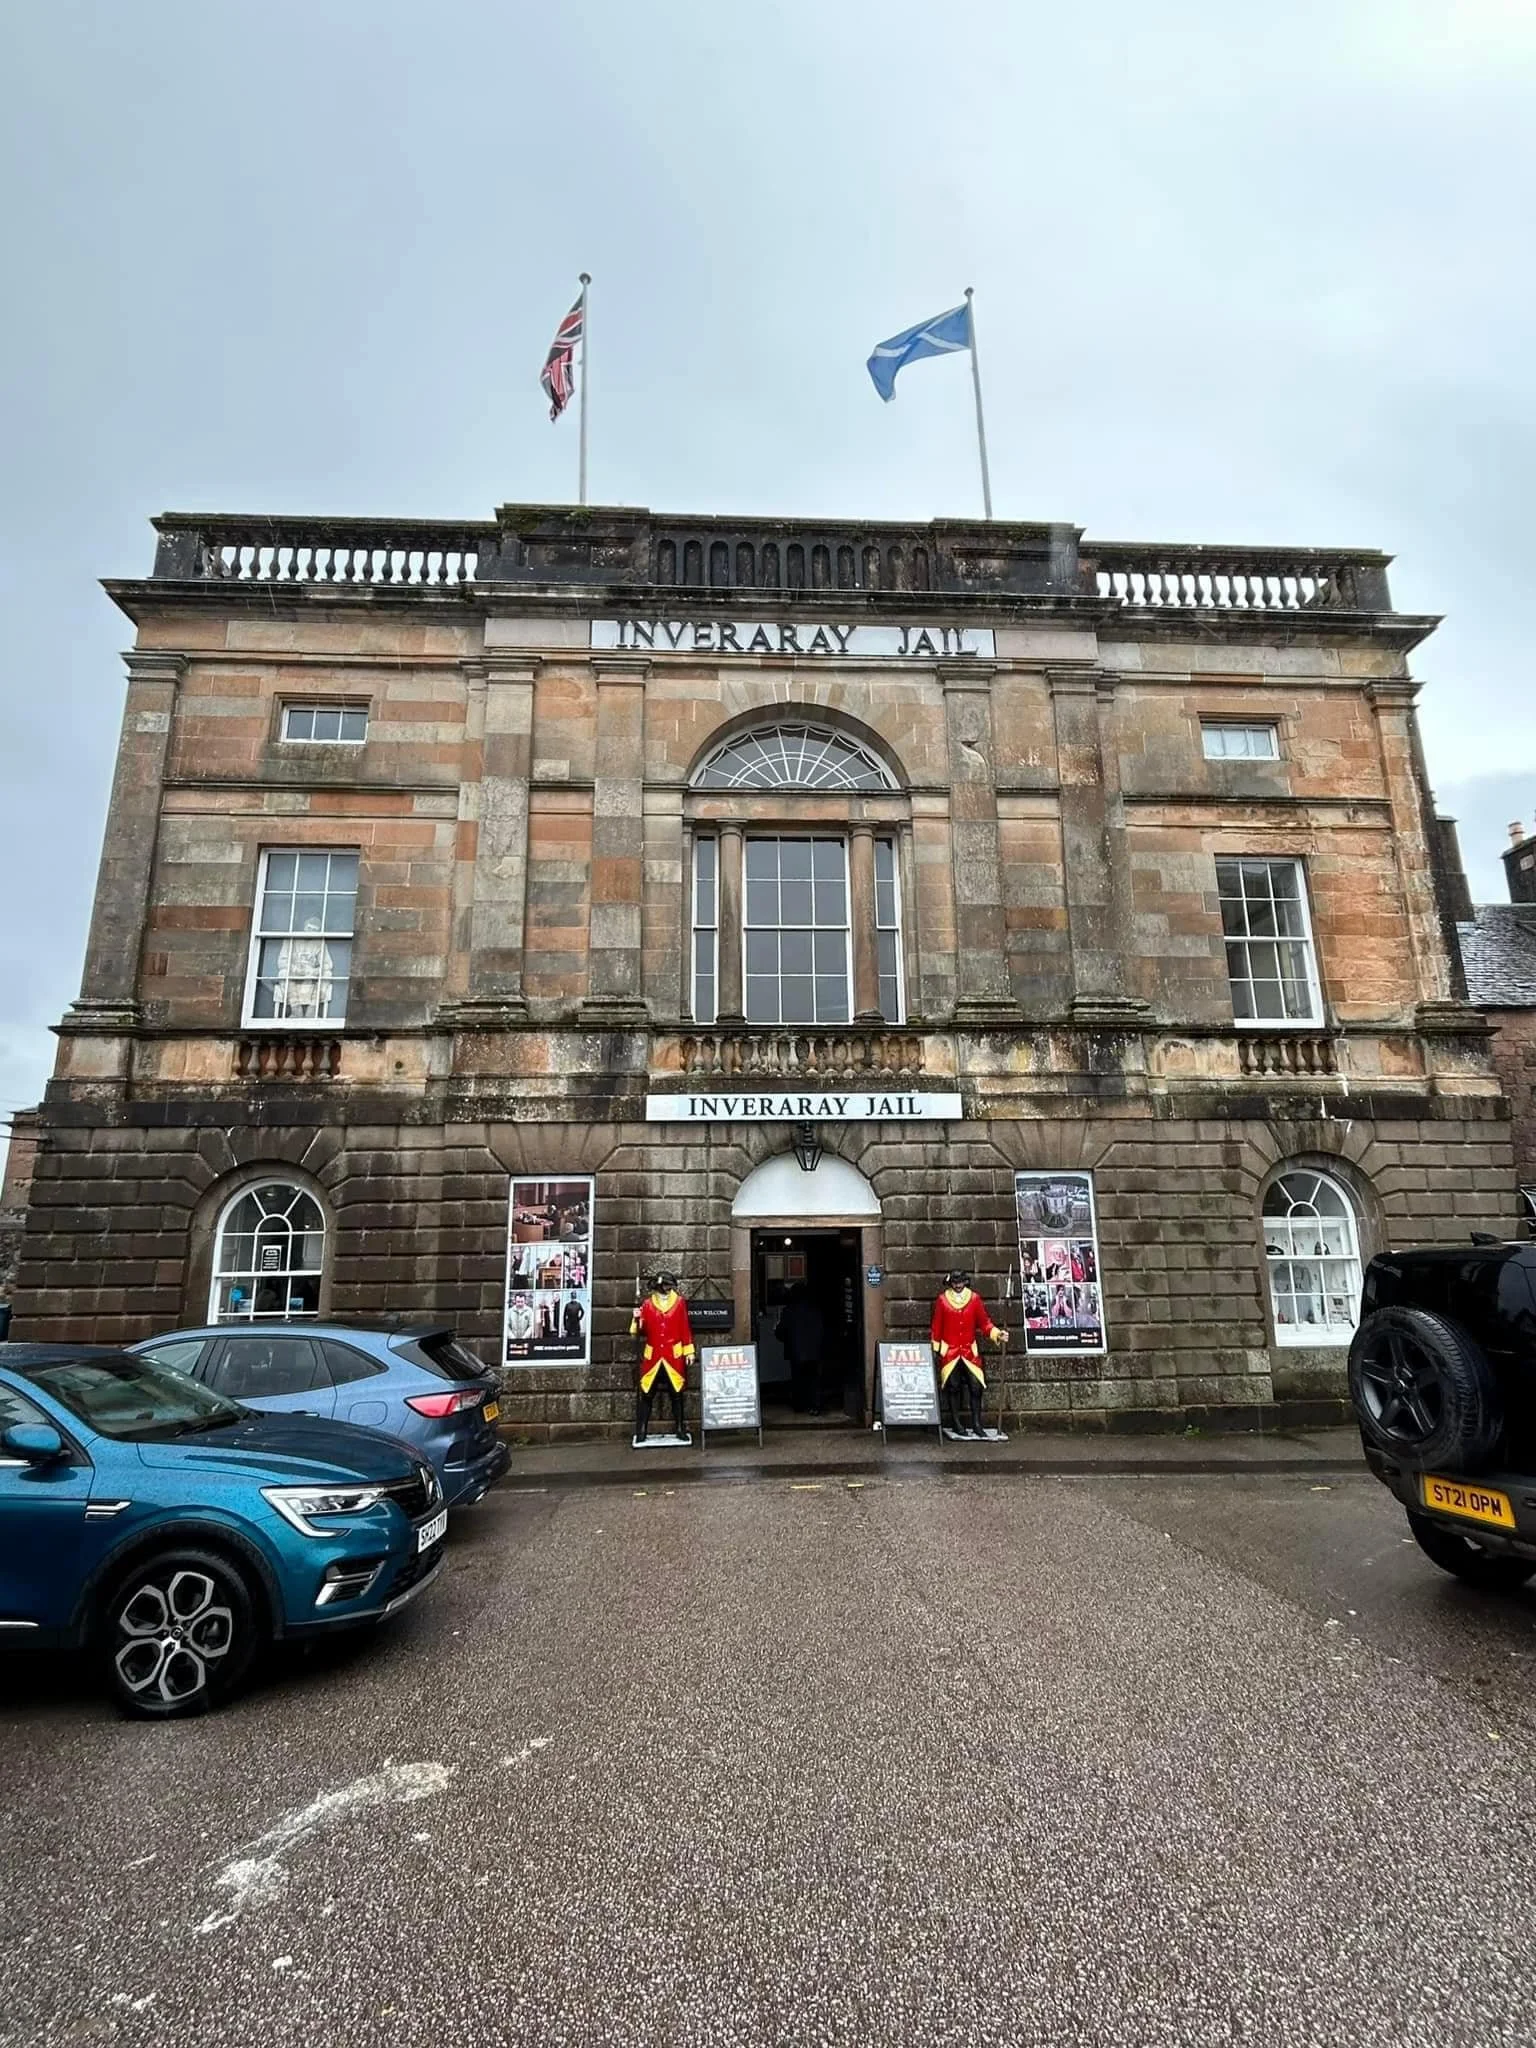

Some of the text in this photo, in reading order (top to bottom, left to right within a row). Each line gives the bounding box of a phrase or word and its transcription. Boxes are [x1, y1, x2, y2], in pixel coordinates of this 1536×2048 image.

[617, 619, 980, 656] INVERARAY JAIL
[688, 1096, 923, 1116] INVERARAY JAIL
[709, 1353, 749, 1366] JAIL
[887, 1349, 926, 1362] JAIL
[1433, 1484, 1504, 1518] ST21 OPM
